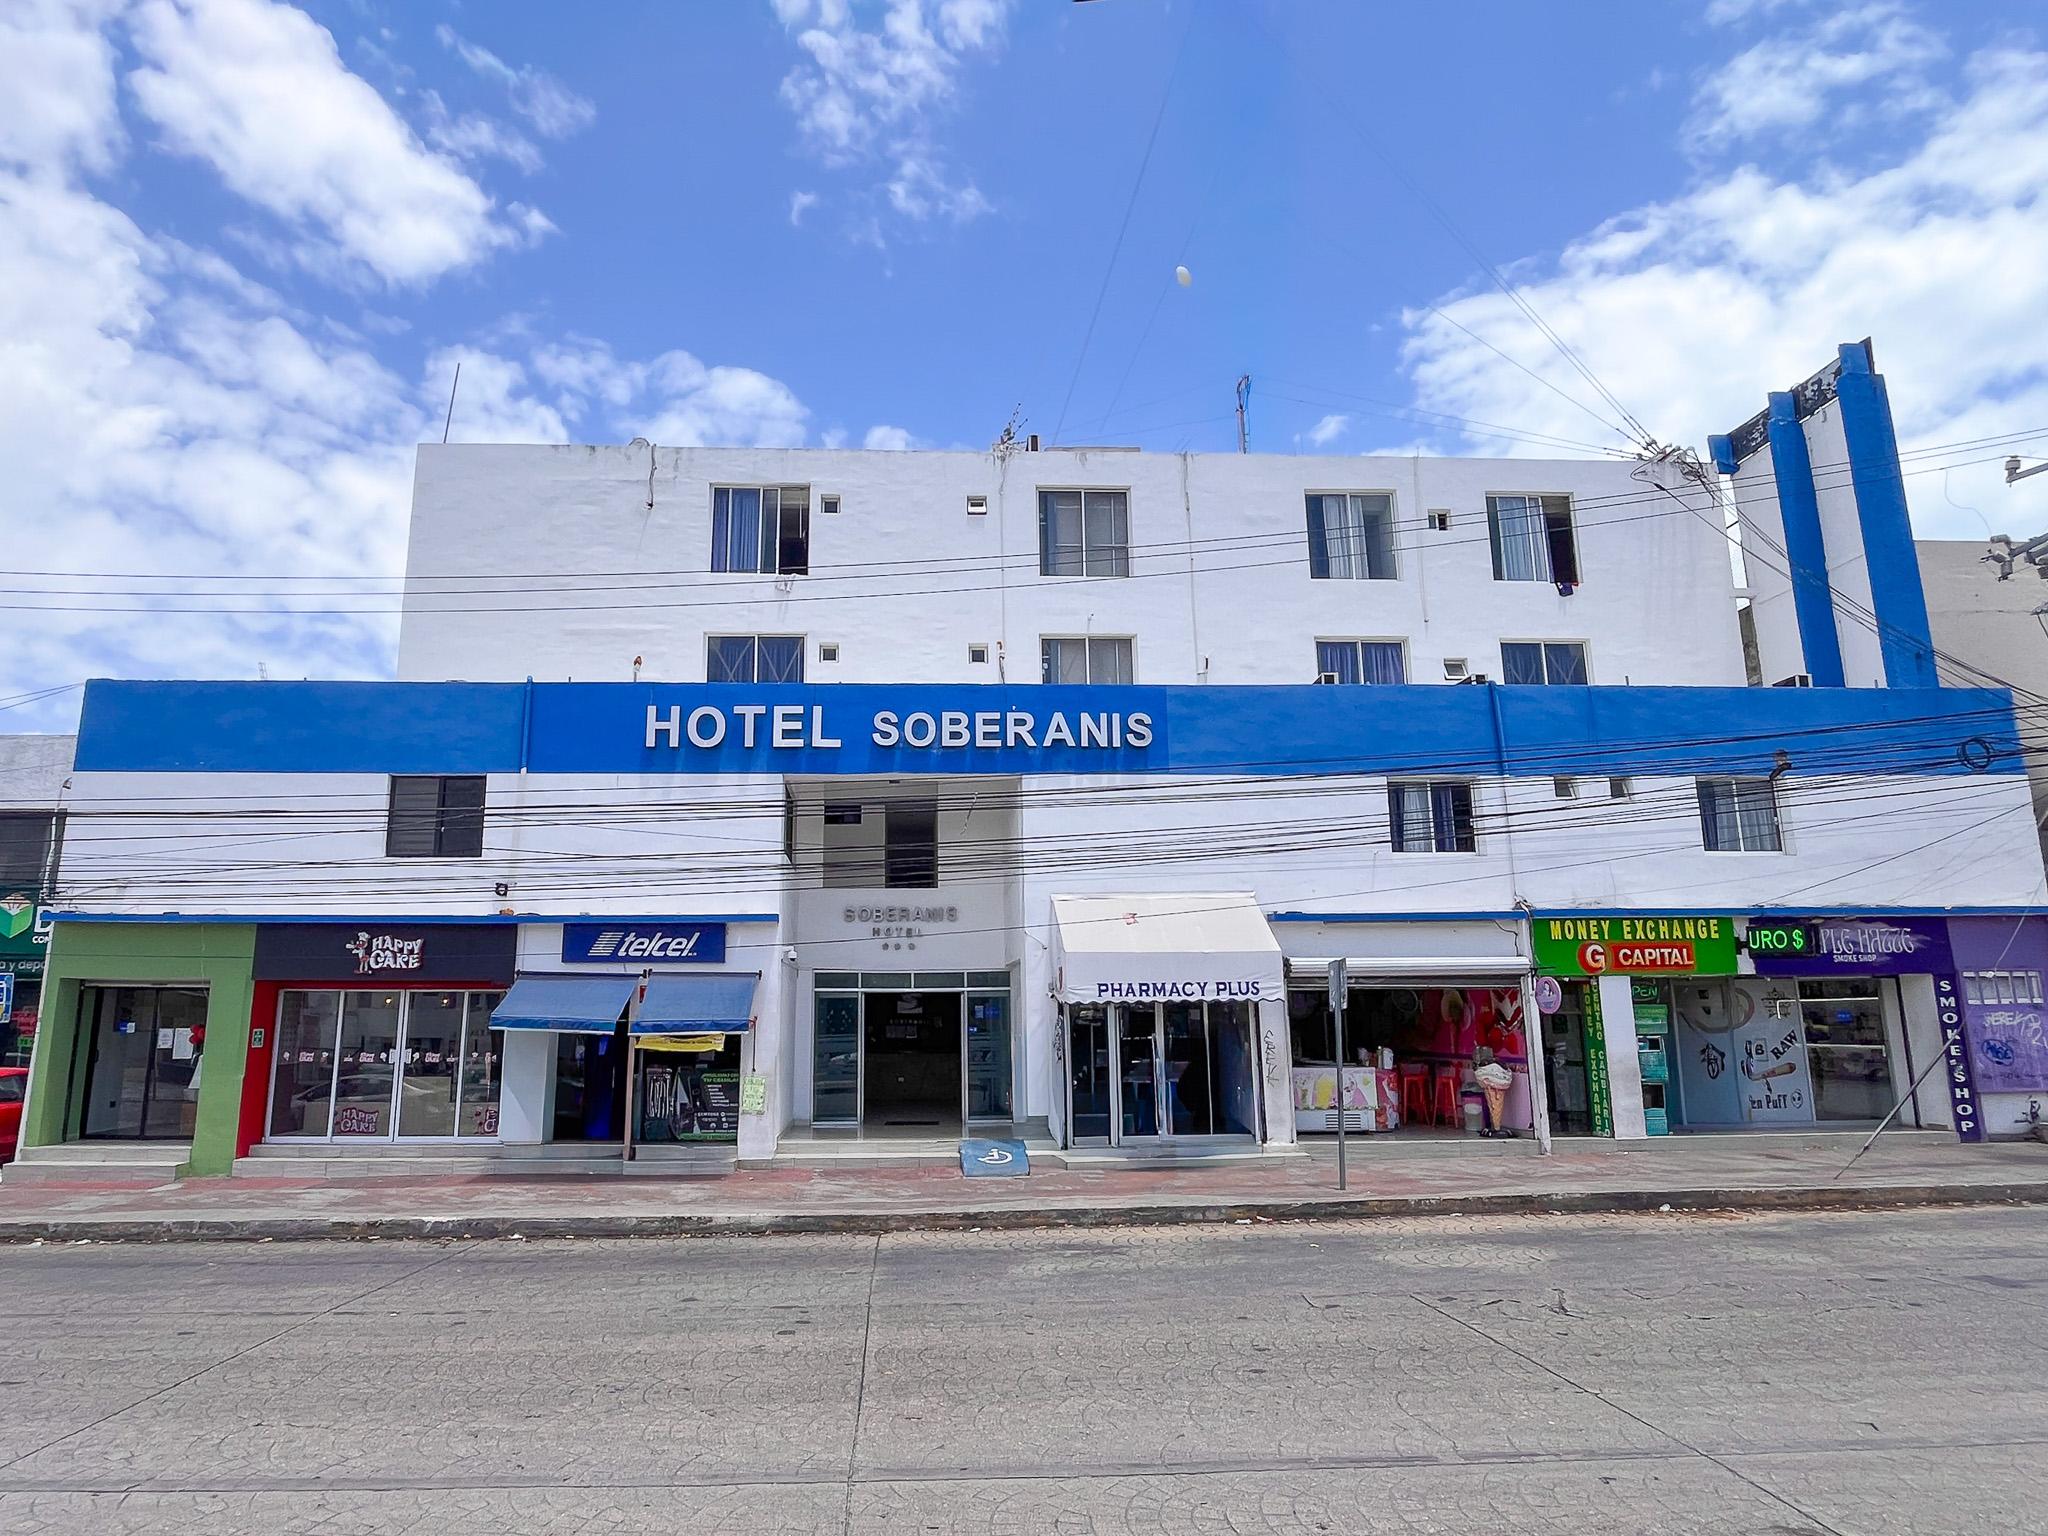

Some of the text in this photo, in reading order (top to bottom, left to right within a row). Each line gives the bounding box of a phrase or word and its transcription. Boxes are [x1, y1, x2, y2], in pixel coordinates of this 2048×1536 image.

[645, 705, 1153, 748] HOTEL SOBERANIS
[843, 906, 958, 923] SOBERANIS
[872, 927, 921, 938] HOTEL
[1550, 919, 1720, 940] MONEY EXCHANGE
[372, 936, 424, 954] HAPPY
[617, 932, 701, 957] telcel
[369, 950, 421, 969] CAKE
[1585, 943, 1695, 969] G CAPITAL
[1833, 954, 1877, 963] SMOKE SHOP
[1097, 981, 1260, 997] PHARMACY PLUS
[1583, 984, 1594, 1037] MONEY
[1770, 1029, 1798, 1060] RAW
[1939, 981, 1975, 1132] SMOKE SHOP
[342, 1109, 378, 1122] HAPPY
[341, 1120, 376, 1133] CAKE
